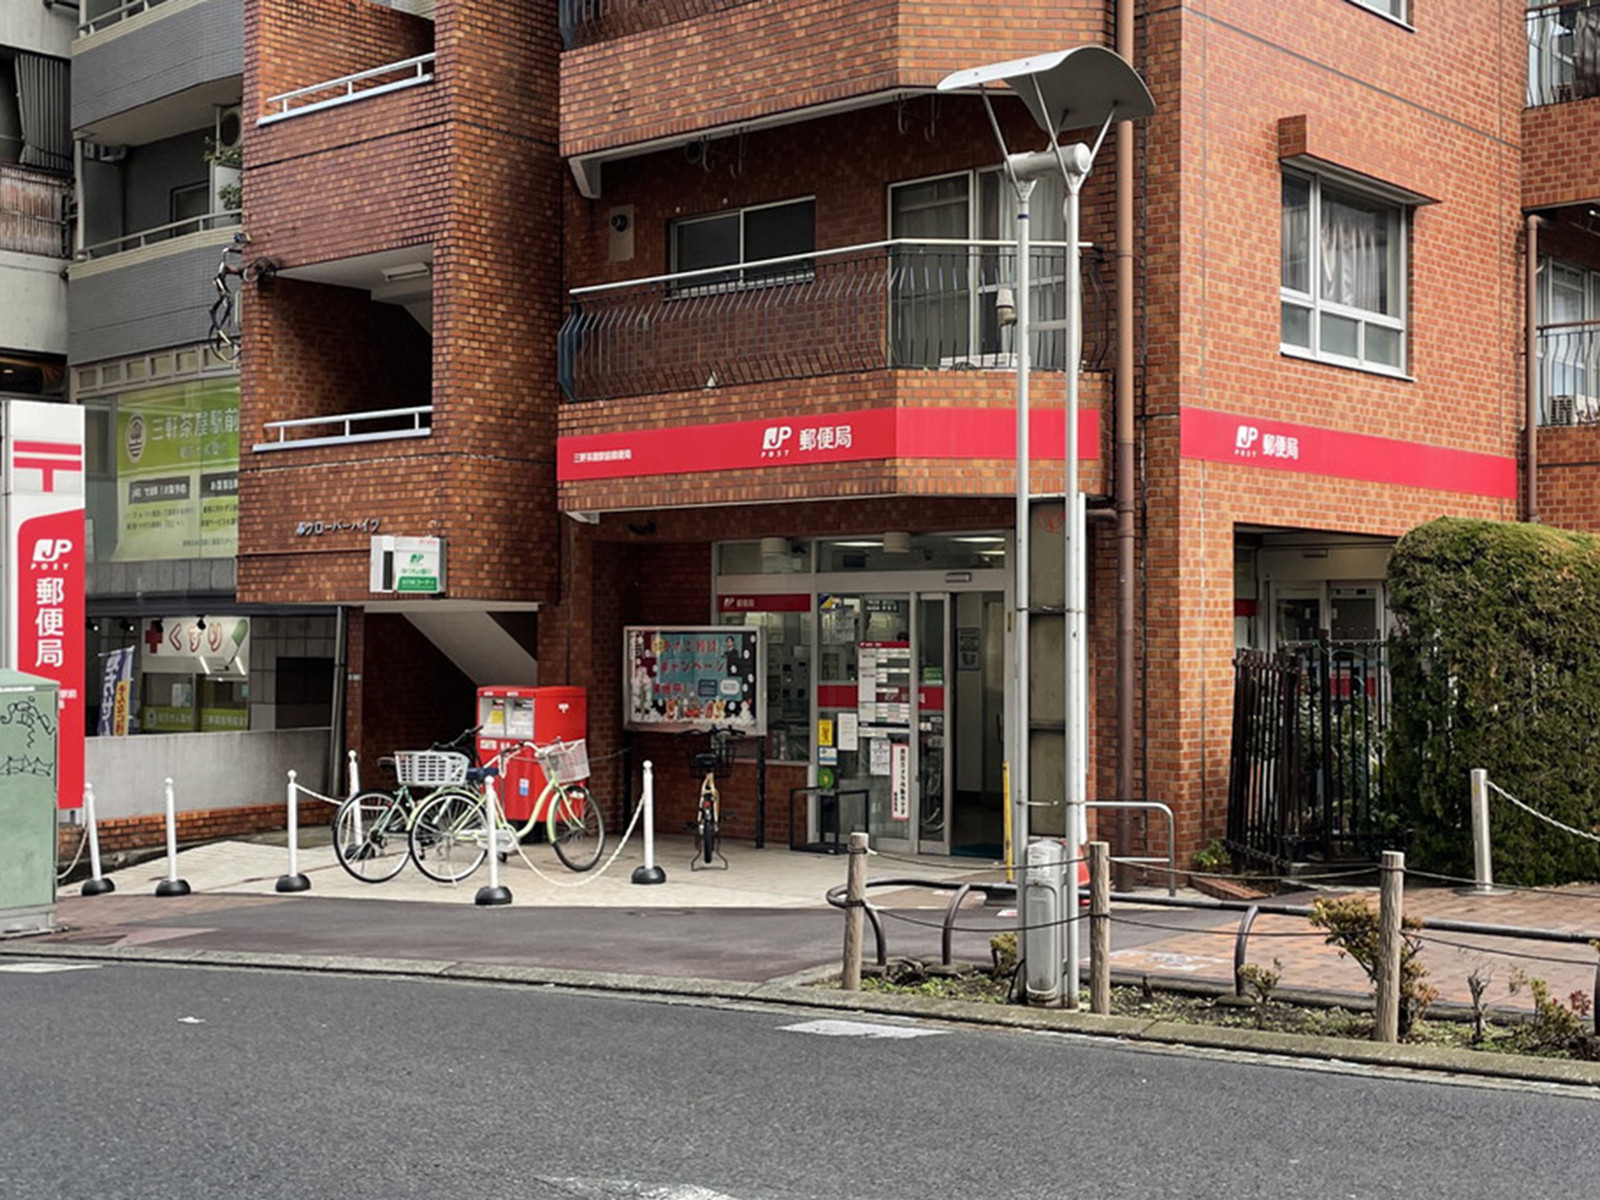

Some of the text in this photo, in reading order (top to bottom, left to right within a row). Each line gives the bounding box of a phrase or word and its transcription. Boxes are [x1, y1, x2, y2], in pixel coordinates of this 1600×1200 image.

[762, 426, 792, 450] JP
[799, 425, 852, 452] 郵便局
[1236, 425, 1259, 449] JP
[1262, 433, 1299, 460] 郵便局
[32, 538, 73, 562] JP
[30, 562, 69, 571] POST
[35, 577, 64, 668] 郵便局
[167, 622, 222, 652] くすり
